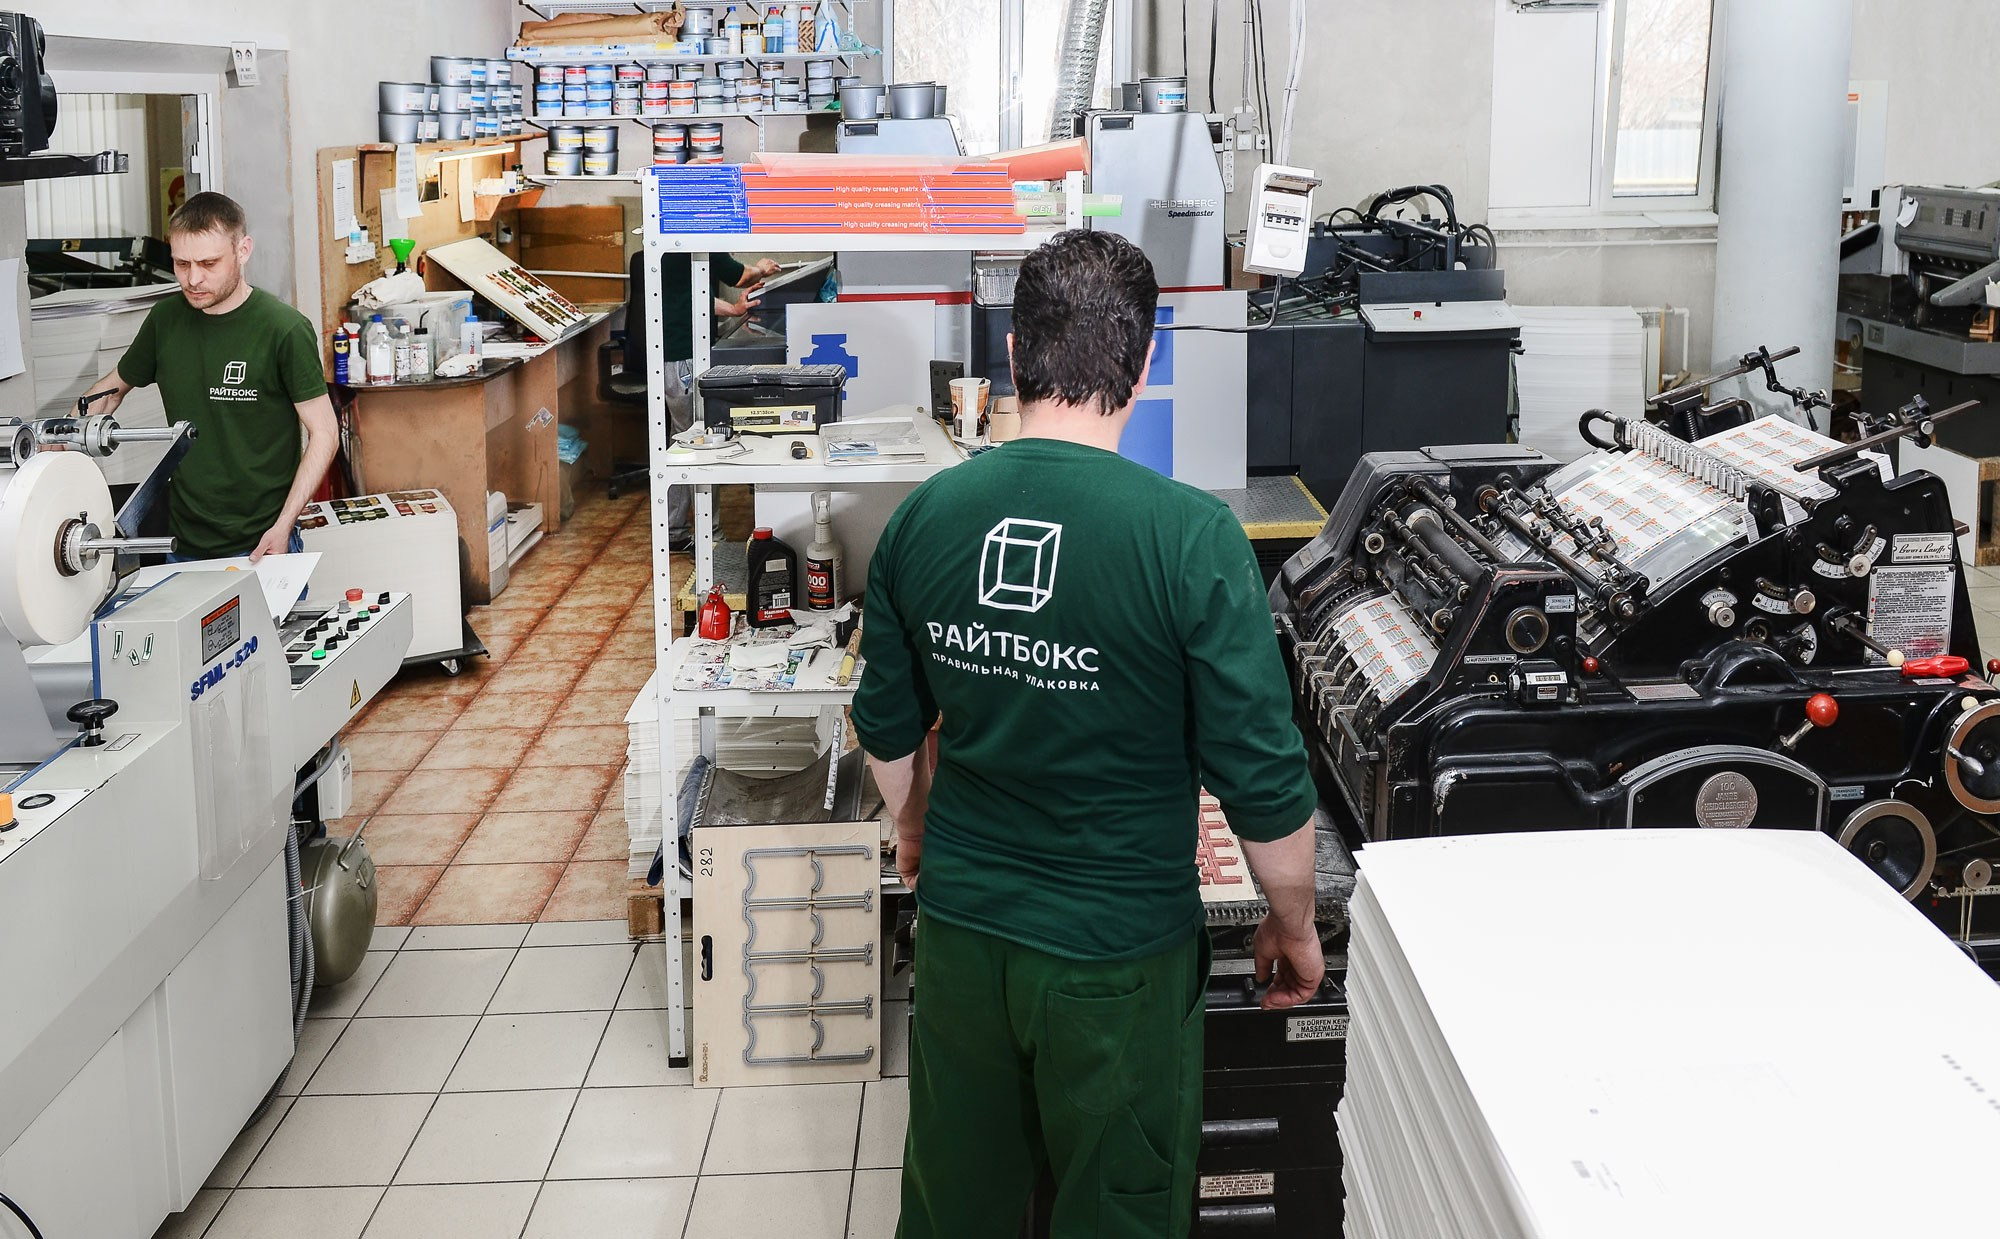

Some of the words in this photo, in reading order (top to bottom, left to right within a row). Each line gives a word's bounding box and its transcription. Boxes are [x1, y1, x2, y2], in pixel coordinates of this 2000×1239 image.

[875, 201, 901, 209] creasing
[1150, 199, 1218, 209] HEIDELBERG
[1167, 210, 1214, 218] Speedmaster
[843, 221, 858, 229] High
[859, 221, 881, 229] quality
[881, 221, 908, 229] creasing
[209, 386, 258, 397] РАЙТБОКС
[926, 621, 1100, 673] РАЙТБОКС
[190, 635, 258, 701] SFML-520
[931, 652, 1019, 680] ПРАВИЛЬНАЯ
[1025, 673, 1100, 691] УПАКОВКА
[1720, 782, 1736, 791] 100
[1704, 800, 1749, 811] HEIDELBERGER
[700, 847, 713, 877] 282
[1295, 1031, 1324, 1039] BENUTZT
